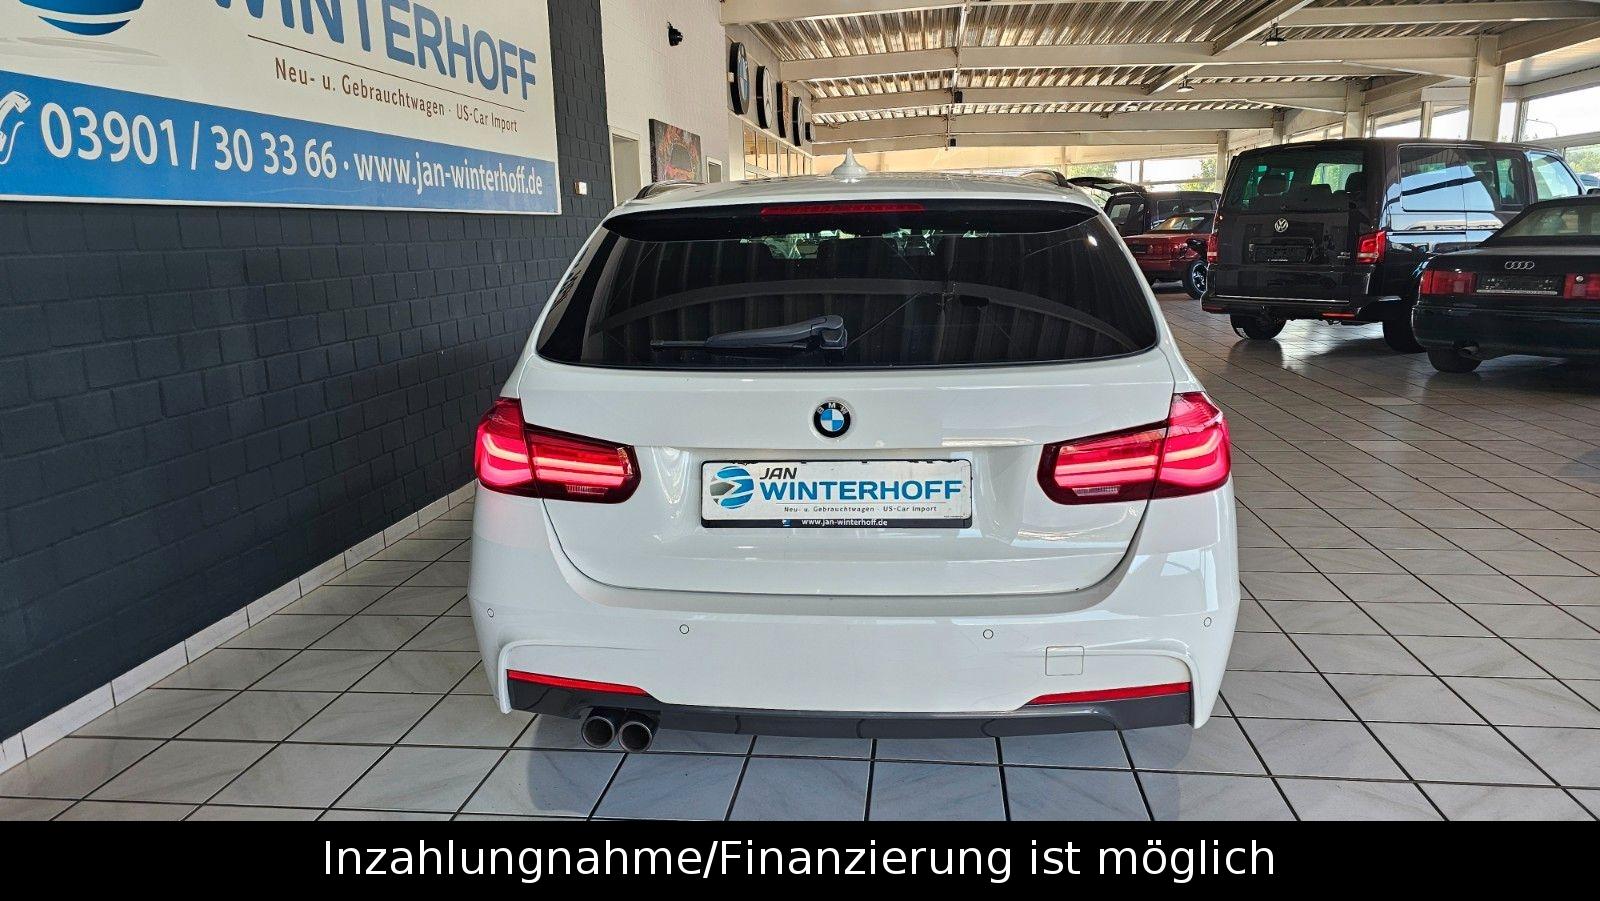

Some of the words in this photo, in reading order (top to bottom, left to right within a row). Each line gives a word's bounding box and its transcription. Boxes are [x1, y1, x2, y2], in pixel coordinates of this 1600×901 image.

[275, 57, 315, 85] Neu-
[322, 75, 336, 91] u.
[342, 74, 445, 117] Gebrauchtwagen
[456, 103, 488, 125] US-Car
[491, 112, 518, 133] Import
[40, 102, 179, 167] 03901
[210, 125, 253, 172] 30
[260, 131, 298, 176] 33
[304, 138, 337, 179] 66
[354, 151, 543, 195] www.jan-winterhoff.de
[759, 467, 798, 480] JAN
[759, 480, 963, 500] WINTERHOFF
[813, 506, 875, 515] Gebrauchtwagen
[883, 505, 911, 513] US-Car
[801, 518, 888, 527] www.jan-winterhoff.de
